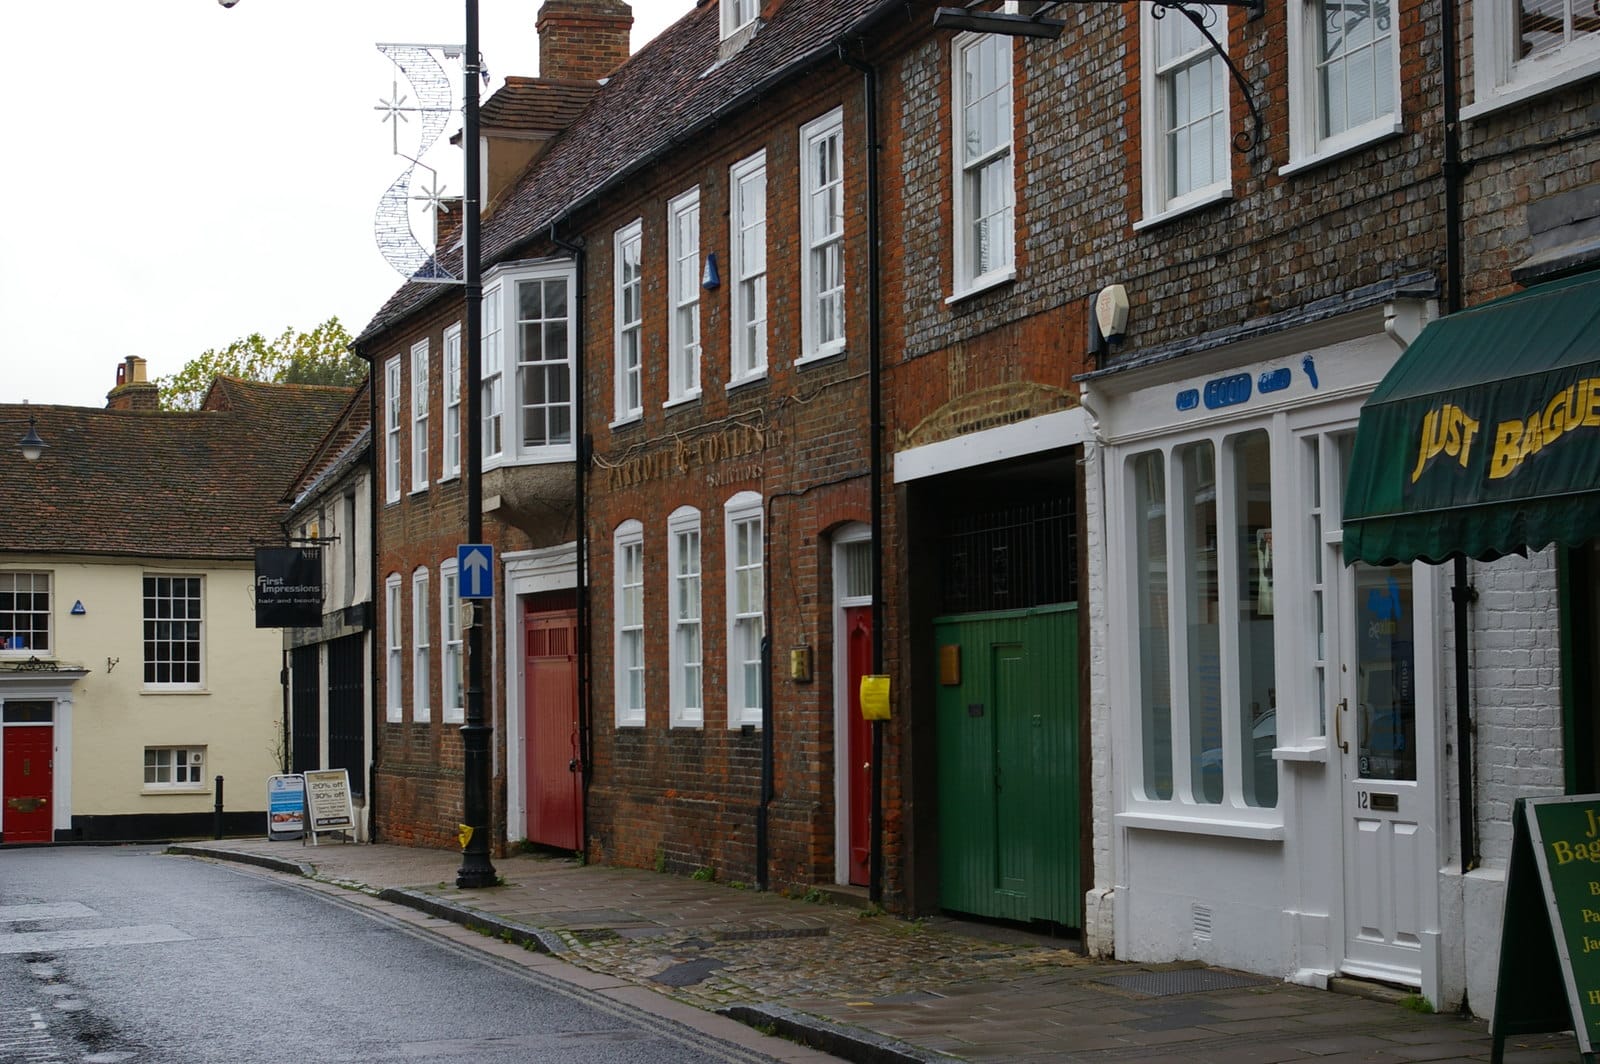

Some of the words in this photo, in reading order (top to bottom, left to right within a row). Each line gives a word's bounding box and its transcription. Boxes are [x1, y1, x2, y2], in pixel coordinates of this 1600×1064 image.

[1411, 403, 1480, 484] JUST
[606, 451, 671, 493] PARROTT
[675, 440, 689, 474] &
[257, 575, 284, 586] First
[263, 583, 320, 594] Impressions
[1357, 791, 1368, 809] 12
